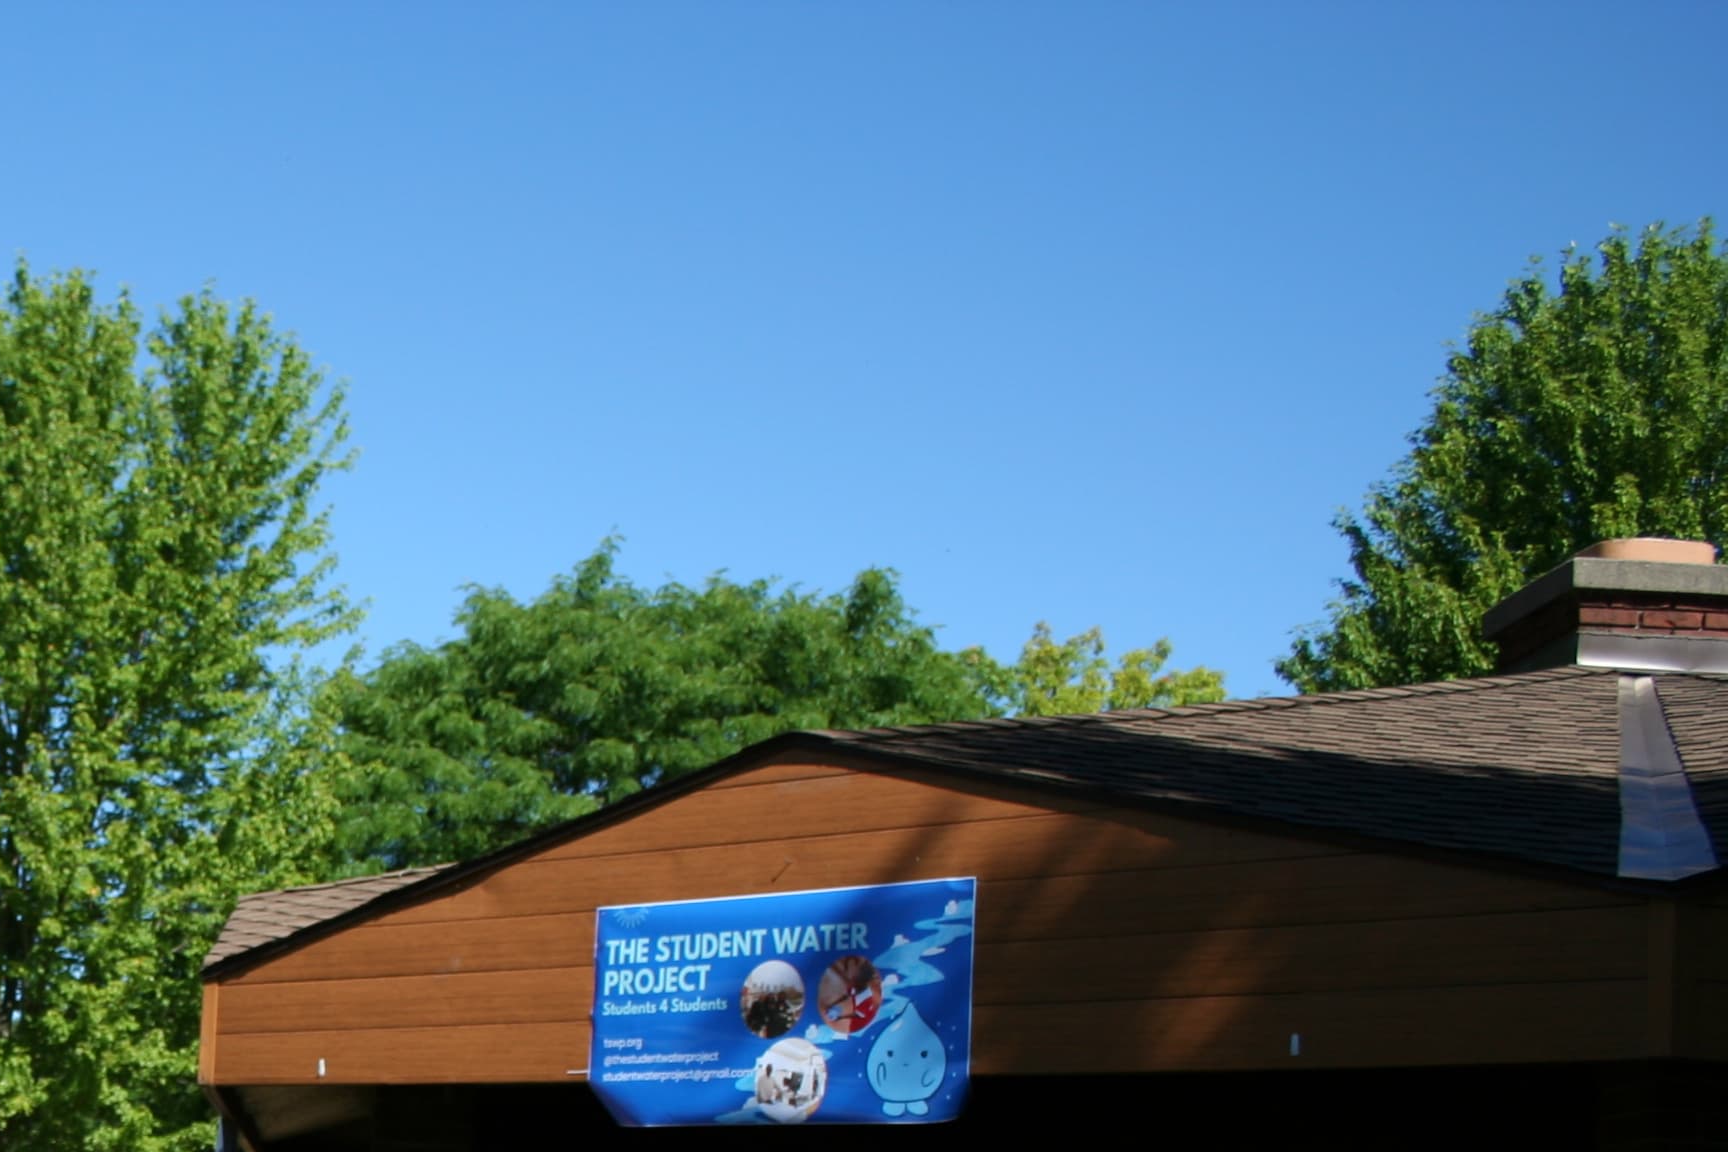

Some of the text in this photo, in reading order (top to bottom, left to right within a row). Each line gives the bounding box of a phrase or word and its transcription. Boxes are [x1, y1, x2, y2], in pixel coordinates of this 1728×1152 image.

[606, 922, 869, 965] THE STUDENT WATER
[603, 964, 711, 997] PROJECT
[602, 996, 728, 1016] Students 4 Students
[603, 1037, 643, 1050] tswp.org
[603, 1052, 719, 1067] @thestudentwaterproject
[602, 1068, 754, 1083] studentwaterproject@gmail.com
